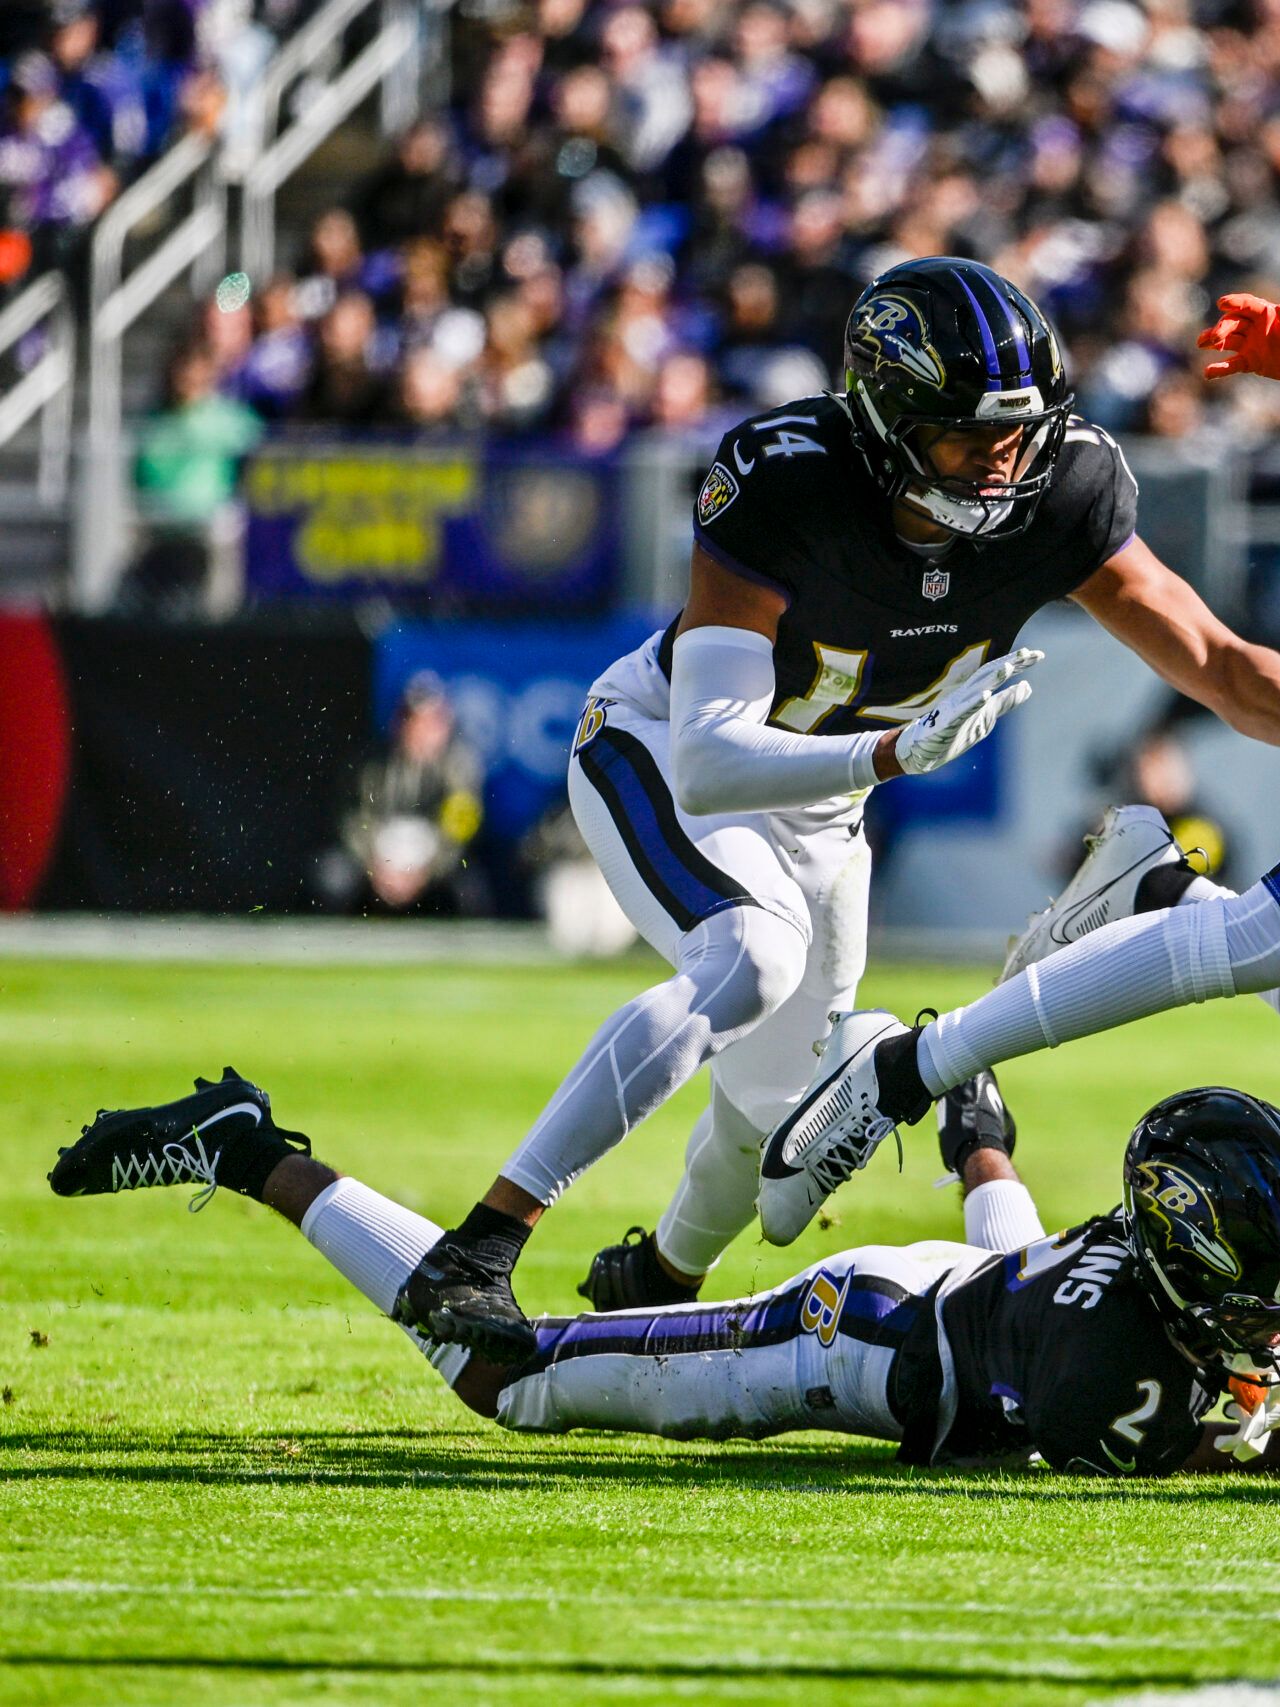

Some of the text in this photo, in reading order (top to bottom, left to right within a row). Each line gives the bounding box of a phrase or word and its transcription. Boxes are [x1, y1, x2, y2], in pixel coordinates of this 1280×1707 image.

[752, 415, 828, 458] 14
[889, 624, 959, 638] RAVENS
[1109, 1378, 1162, 1445] 2
